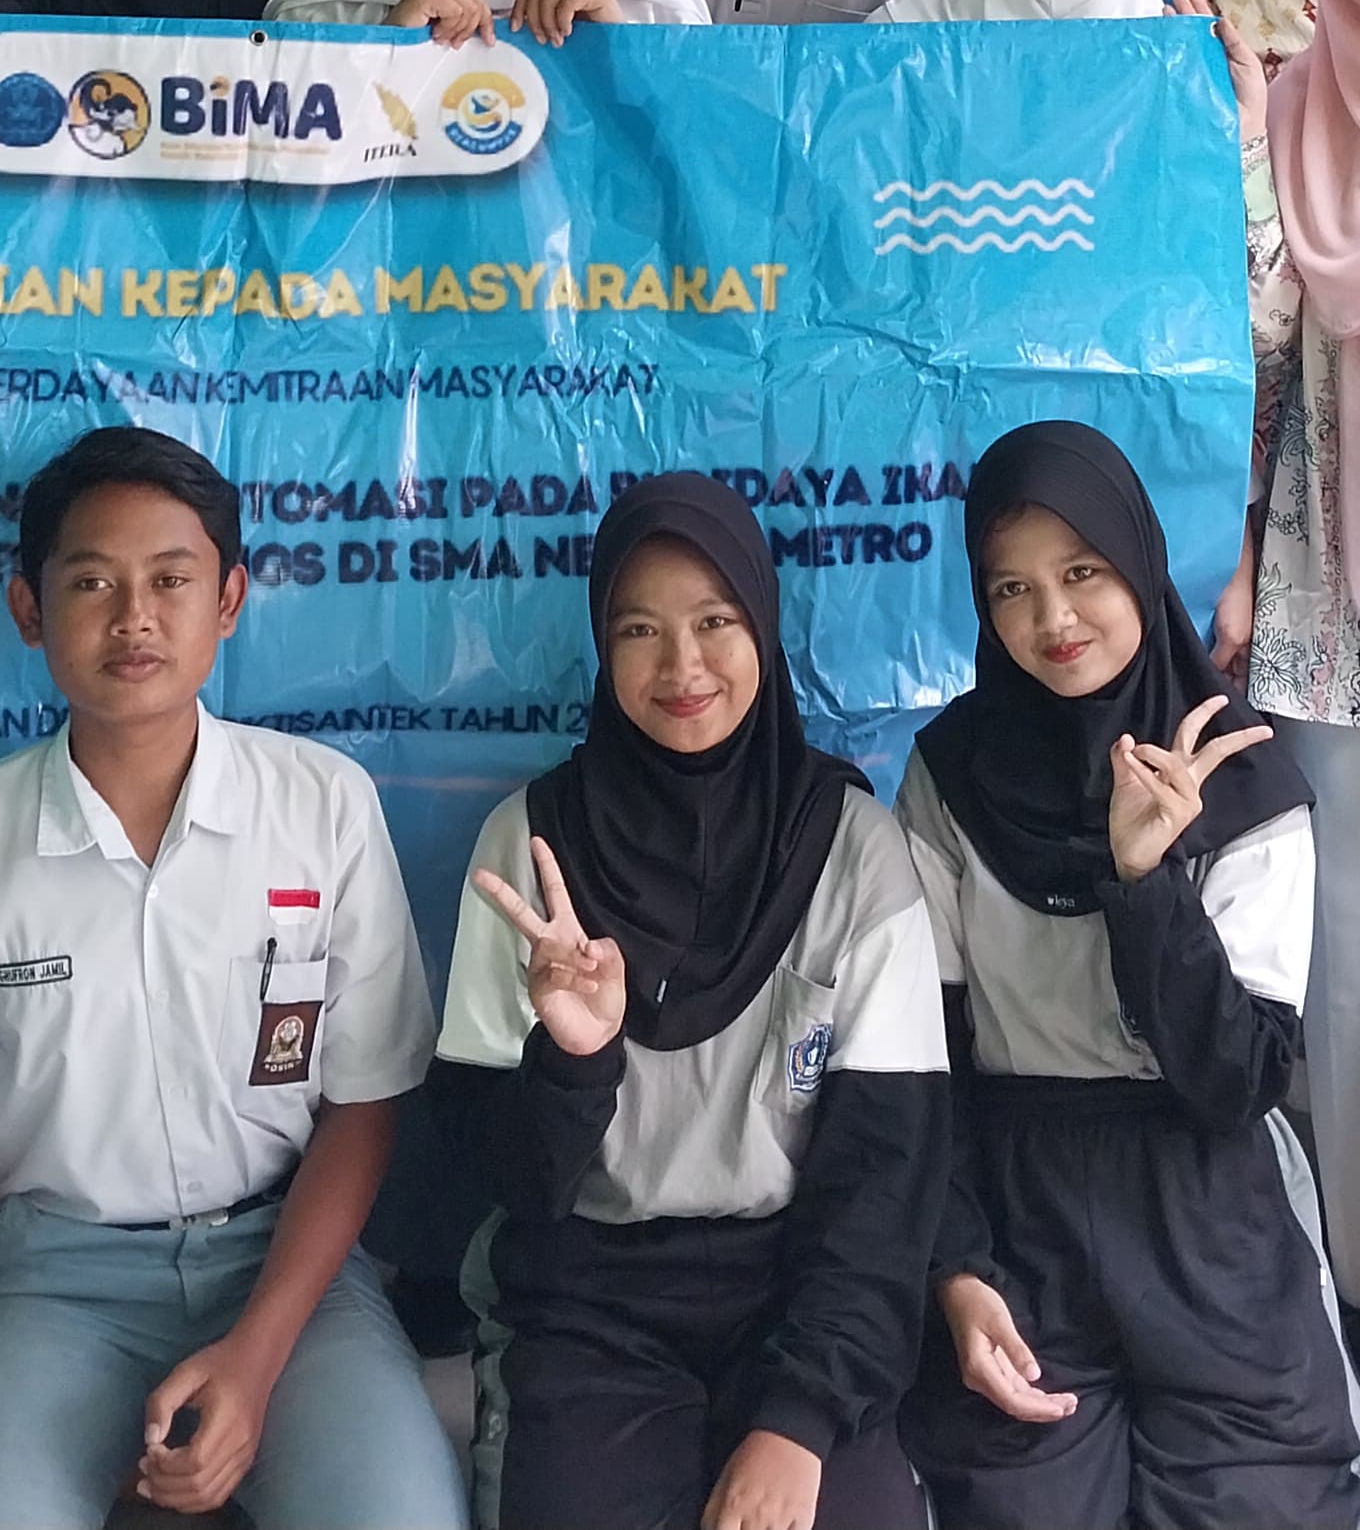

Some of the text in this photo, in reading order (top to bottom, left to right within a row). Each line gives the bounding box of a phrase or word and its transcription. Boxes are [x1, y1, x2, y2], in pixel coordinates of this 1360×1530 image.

[121, 266, 364, 320] KEPADA
[375, 263, 787, 315] MASYARAKAT
[242, 478, 447, 524] TOMASI
[460, 473, 599, 517] PADA
[882, 460, 976, 505] IKA
[339, 539, 398, 583] DI
[409, 536, 522, 581] SMA
[770, 521, 933, 568] METRO
[440, 703, 558, 733] TAHUN
